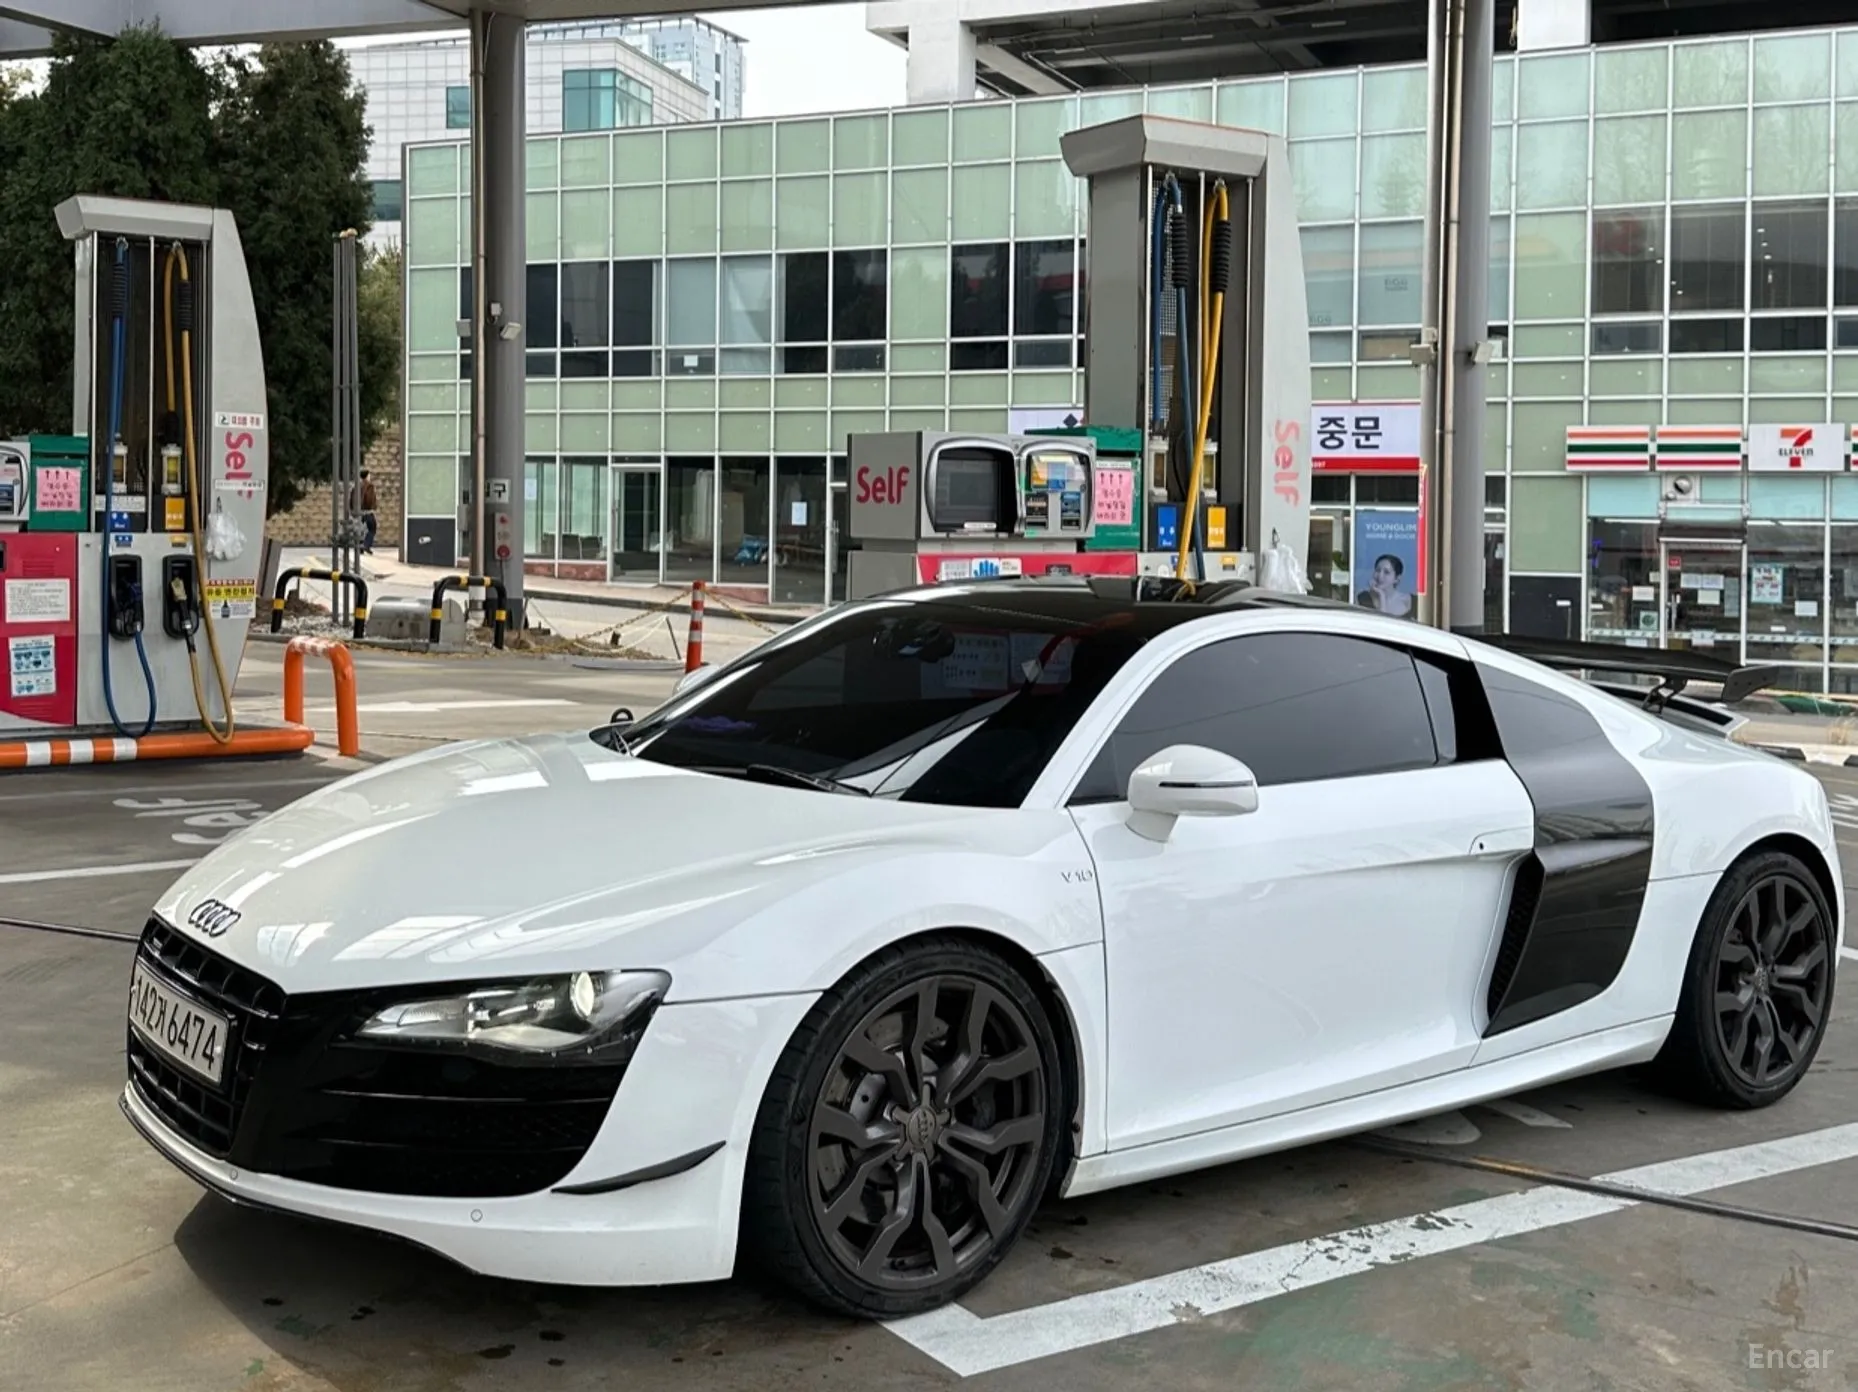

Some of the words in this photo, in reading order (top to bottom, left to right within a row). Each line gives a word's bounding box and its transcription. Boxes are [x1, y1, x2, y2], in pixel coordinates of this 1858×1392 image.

[1317, 416, 1382, 450] 중문
[856, 466, 910, 505] Self
[1274, 419, 1299, 506] Self
[167, 1003, 217, 1070] 6474
